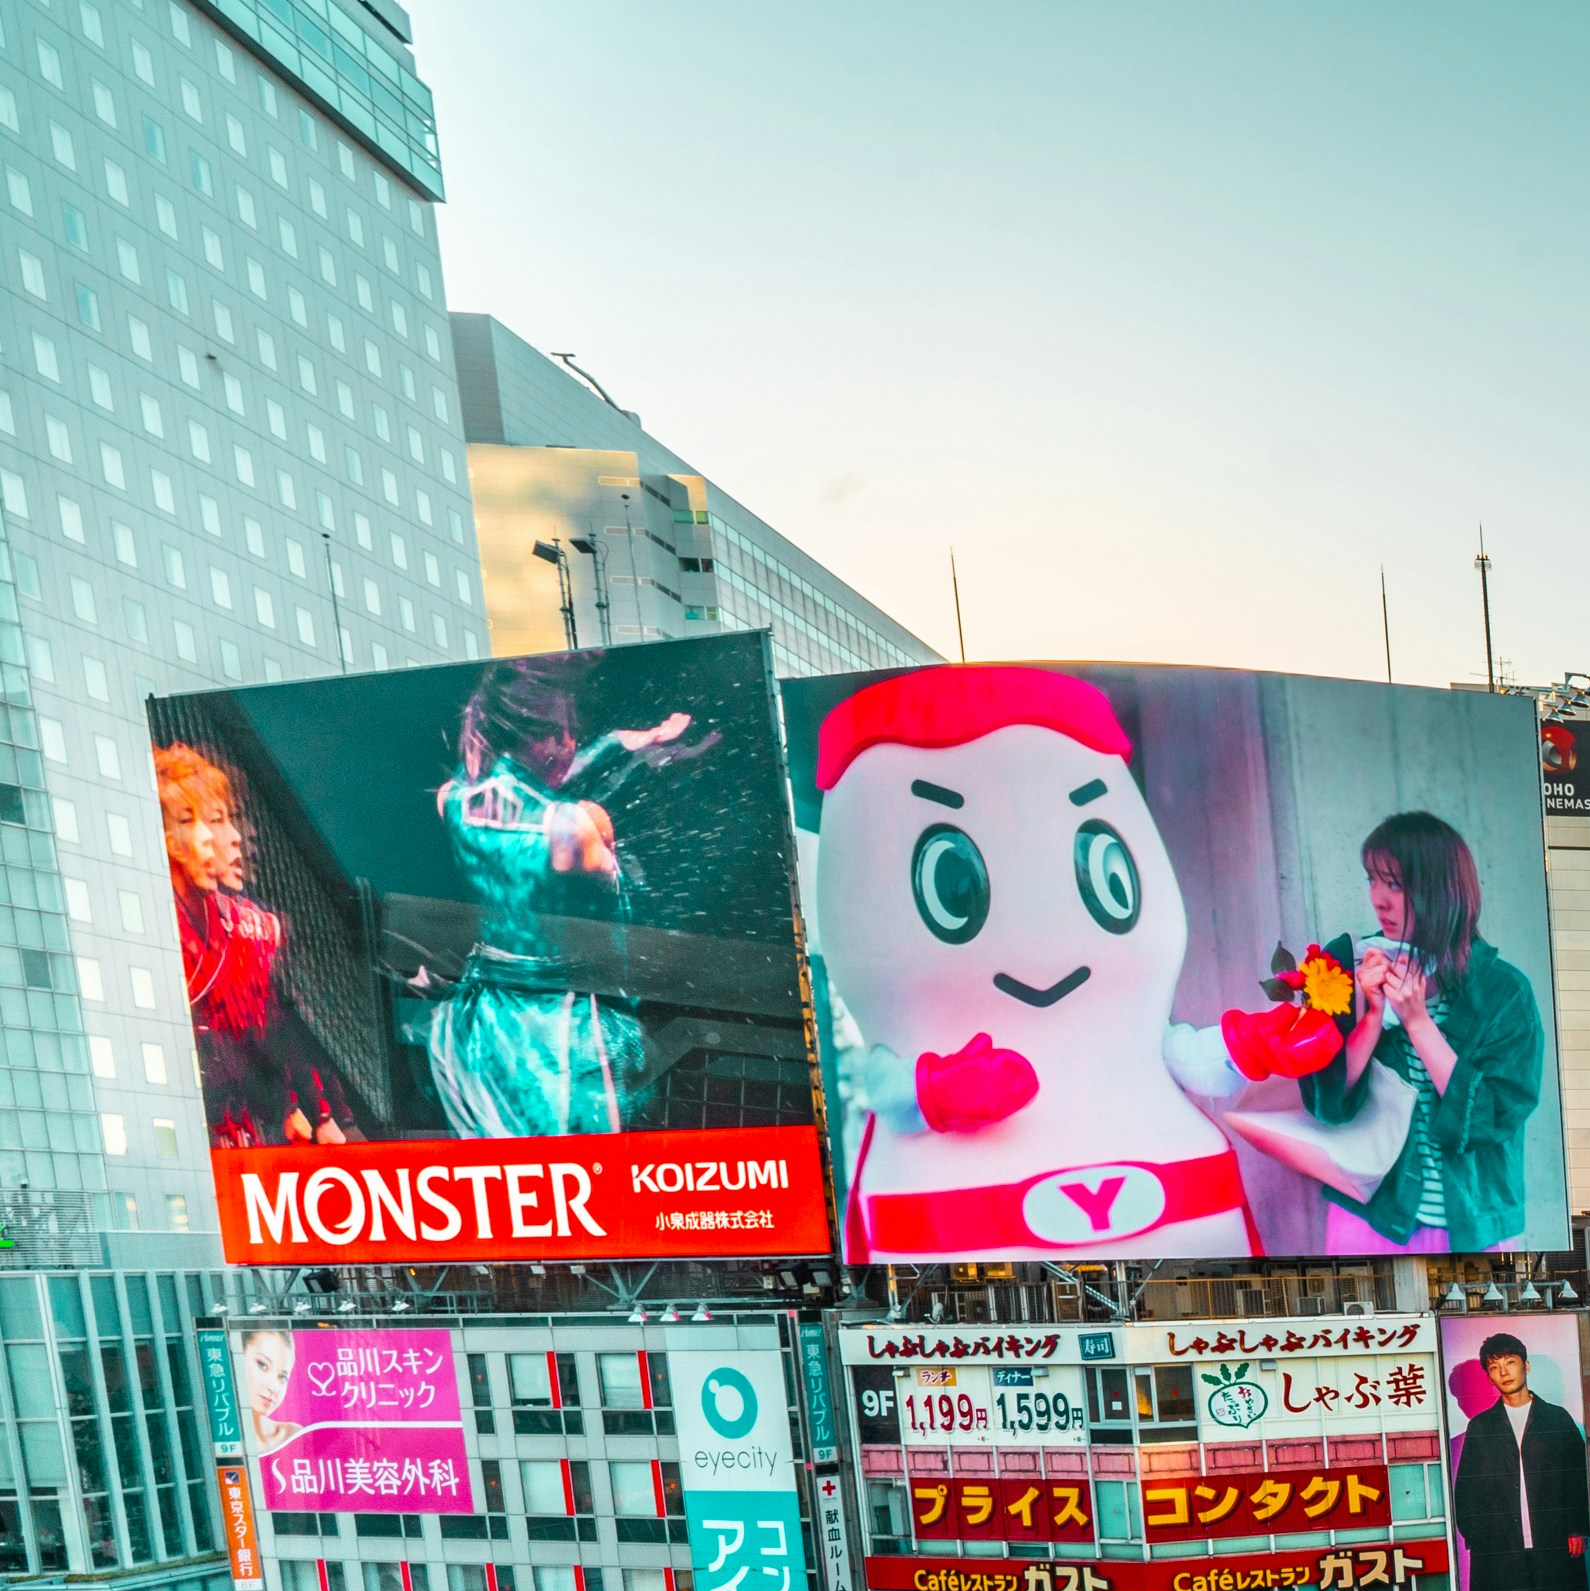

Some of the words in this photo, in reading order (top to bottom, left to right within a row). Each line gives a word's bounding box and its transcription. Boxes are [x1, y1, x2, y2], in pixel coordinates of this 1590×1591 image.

[1543, 783, 1575, 796] OHO
[631, 1160, 790, 1194] KOIZUMI
[241, 1163, 608, 1245] MONSTER
[655, 1209, 775, 1231] 小泉成器株式会社
[867, 1334, 1061, 1359] しゃぶしゃぶバイキング
[1167, 1323, 1420, 1356] しゃぶしゃぶバイキング
[336, 1347, 443, 1376] 品川スキン
[920, 1370, 951, 1385] ランチ
[995, 1370, 1031, 1385] ディナー
[206, 1347, 235, 1436] 東急リバブル
[341, 1380, 436, 1408] クリニック
[806, 1344, 830, 1441] 東急リバブル
[862, 1389, 894, 1418] 9F
[1282, 1364, 1427, 1413] しゃぶ葉
[906, 1393, 988, 1438] 1,199円
[996, 1392, 1084, 1437] 1,599円
[220, 1443, 236, 1454] 9F
[695, 1447, 777, 1475] eyecity
[818, 1449, 832, 1460] 9F
[292, 1457, 459, 1496] 品川美容外科
[914, 1484, 1090, 1528] プライス
[1146, 1474, 1381, 1527] コンタクト
[228, 1487, 254, 1577] 東京スター銀行
[1319, 1549, 1423, 1591] ガスト
